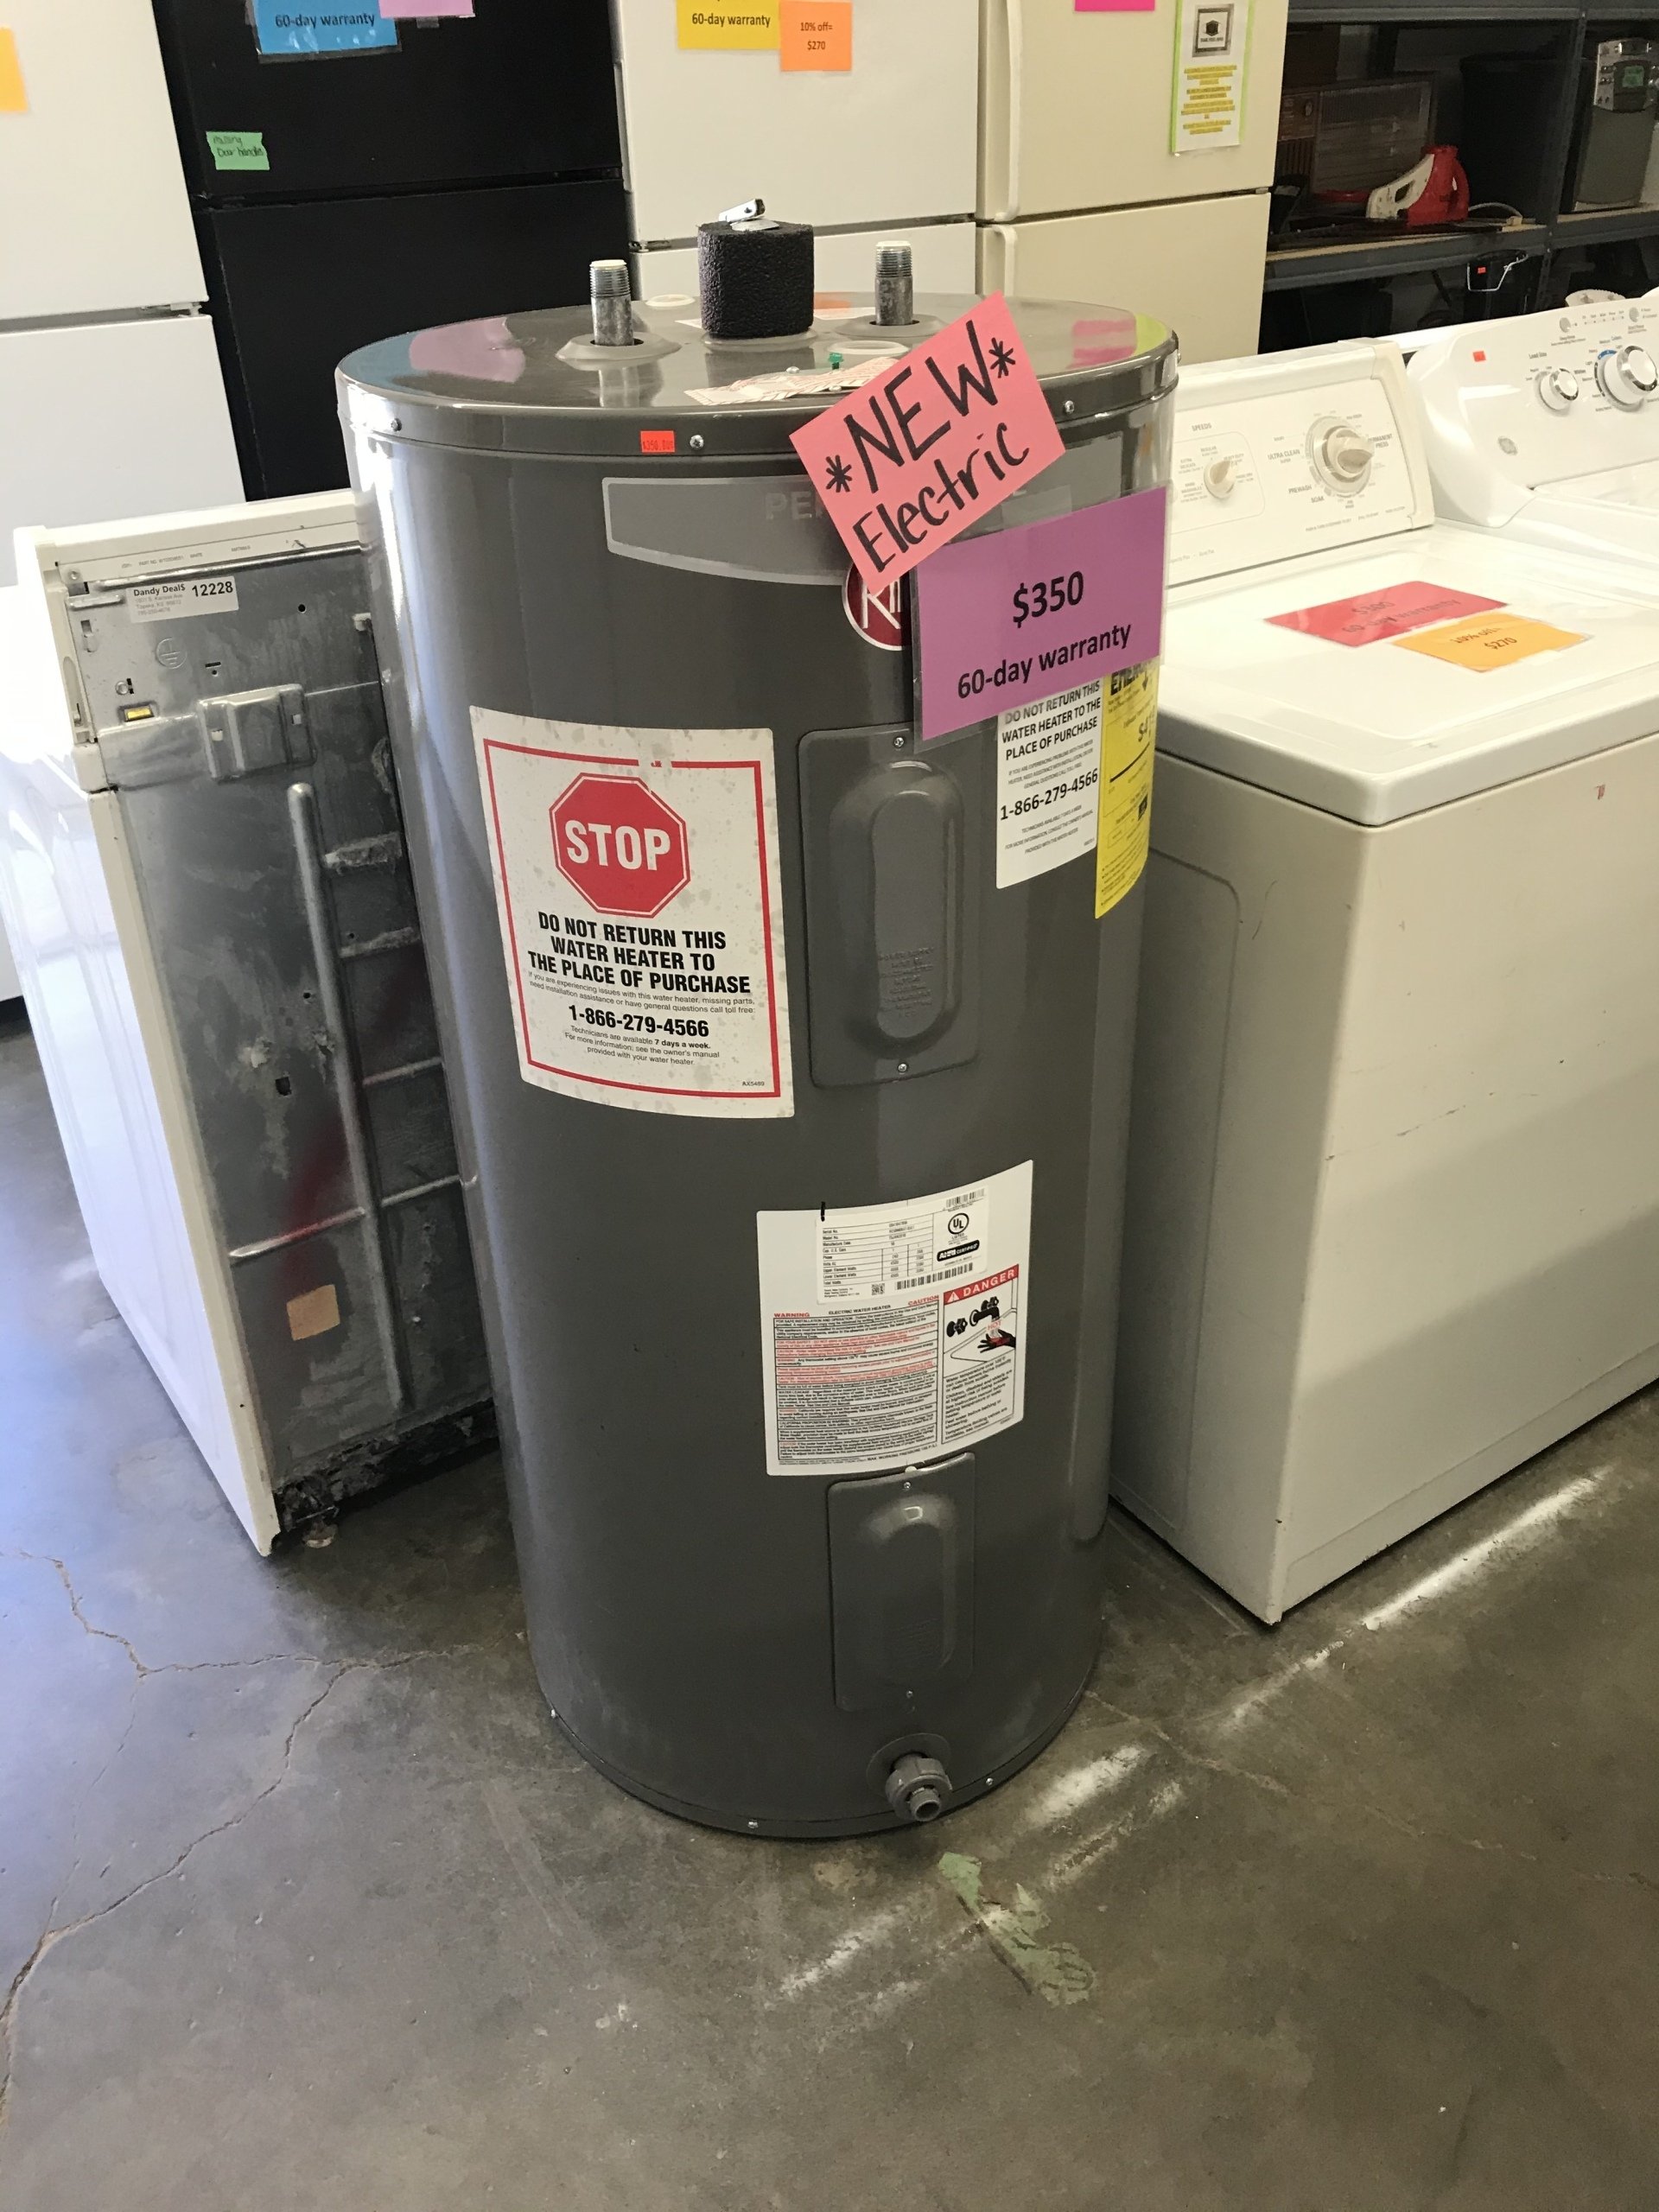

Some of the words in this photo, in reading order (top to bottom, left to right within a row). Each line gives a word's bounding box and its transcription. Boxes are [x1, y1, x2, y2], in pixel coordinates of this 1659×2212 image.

[275, 14, 317, 29] 60-day
[321, 13, 376, 27] warranty
[691, 13, 725, 28] 60-day
[728, 15, 771, 29] warranty
[800, 22, 816, 32] 10%
[817, 22, 833, 32] off=
[807, 41, 826, 50] $270
[852, 422, 1030, 572] Electric
[133, 587, 160, 597] Dandy
[191, 581, 233, 597] 12228
[1012, 569, 1085, 628] $350
[1397, 598, 1461, 620] warranty
[1484, 636, 1517, 650] $270
[957, 657, 1033, 699] 60-day
[1038, 619, 1132, 672] warranty
[1005, 709, 1020, 725] DO
[1022, 702, 1044, 720] NOT
[1046, 688, 1081, 712] RETURN
[1083, 680, 1101, 699] THIS
[1001, 723, 1037, 744] WATER
[1038, 710, 1072, 733] HEATER
[1073, 707, 1085, 720] TO
[1085, 696, 1102, 715] THE
[1005, 741, 1037, 761] PLACE
[1039, 734, 1052, 750] OF
[1053, 715, 1098, 745] PURCHASE
[1000, 767, 1098, 821] 1-866-279-4566
[564, 819, 671, 872] STOP
[538, 911, 560, 932] DO
[564, 917, 597, 939] NOT
[603, 923, 677, 947] RETURN
[682, 930, 726, 950] THIS
[550, 935, 609, 963] WATER
[613, 946, 684, 969] HEATER
[690, 952, 715, 971] TO
[527, 950, 557, 974] THE
[561, 958, 615, 985] PLACE
[620, 969, 643, 988] OF
[649, 971, 751, 994] PURCHASE
[529, 980, 544, 989] need
[545, 984, 578, 998] installation
[579, 992, 614, 1004] assistance
[625, 999, 642, 1007] have
[643, 1001, 671, 1010] general
[672, 1004, 709, 1013] questions
[556, 979, 598, 994] experiencing
[598, 986, 620, 996] issues
[622, 989, 637, 999] with
[638, 991, 651, 1000] this
[702, 996, 731, 1006] missing
[569, 1004, 709, 1038] 1-866-279-4566
[564, 1032, 575, 1040] For
[576, 1036, 594, 1045] more
[663, 1048, 691, 1057] owner's
[570, 1025, 609, 1039] Technicians
[622, 1034, 653, 1045] available
[661, 1039, 680, 1048] days
[587, 1046, 616, 1057] provided
[616, 1051, 631, 1059] with
[649, 1055, 669, 1064] water
[953, 1217, 964, 1229] UL
[963, 1268, 1015, 1297] DANGER
[907, 1294, 939, 1306] CAUTION
